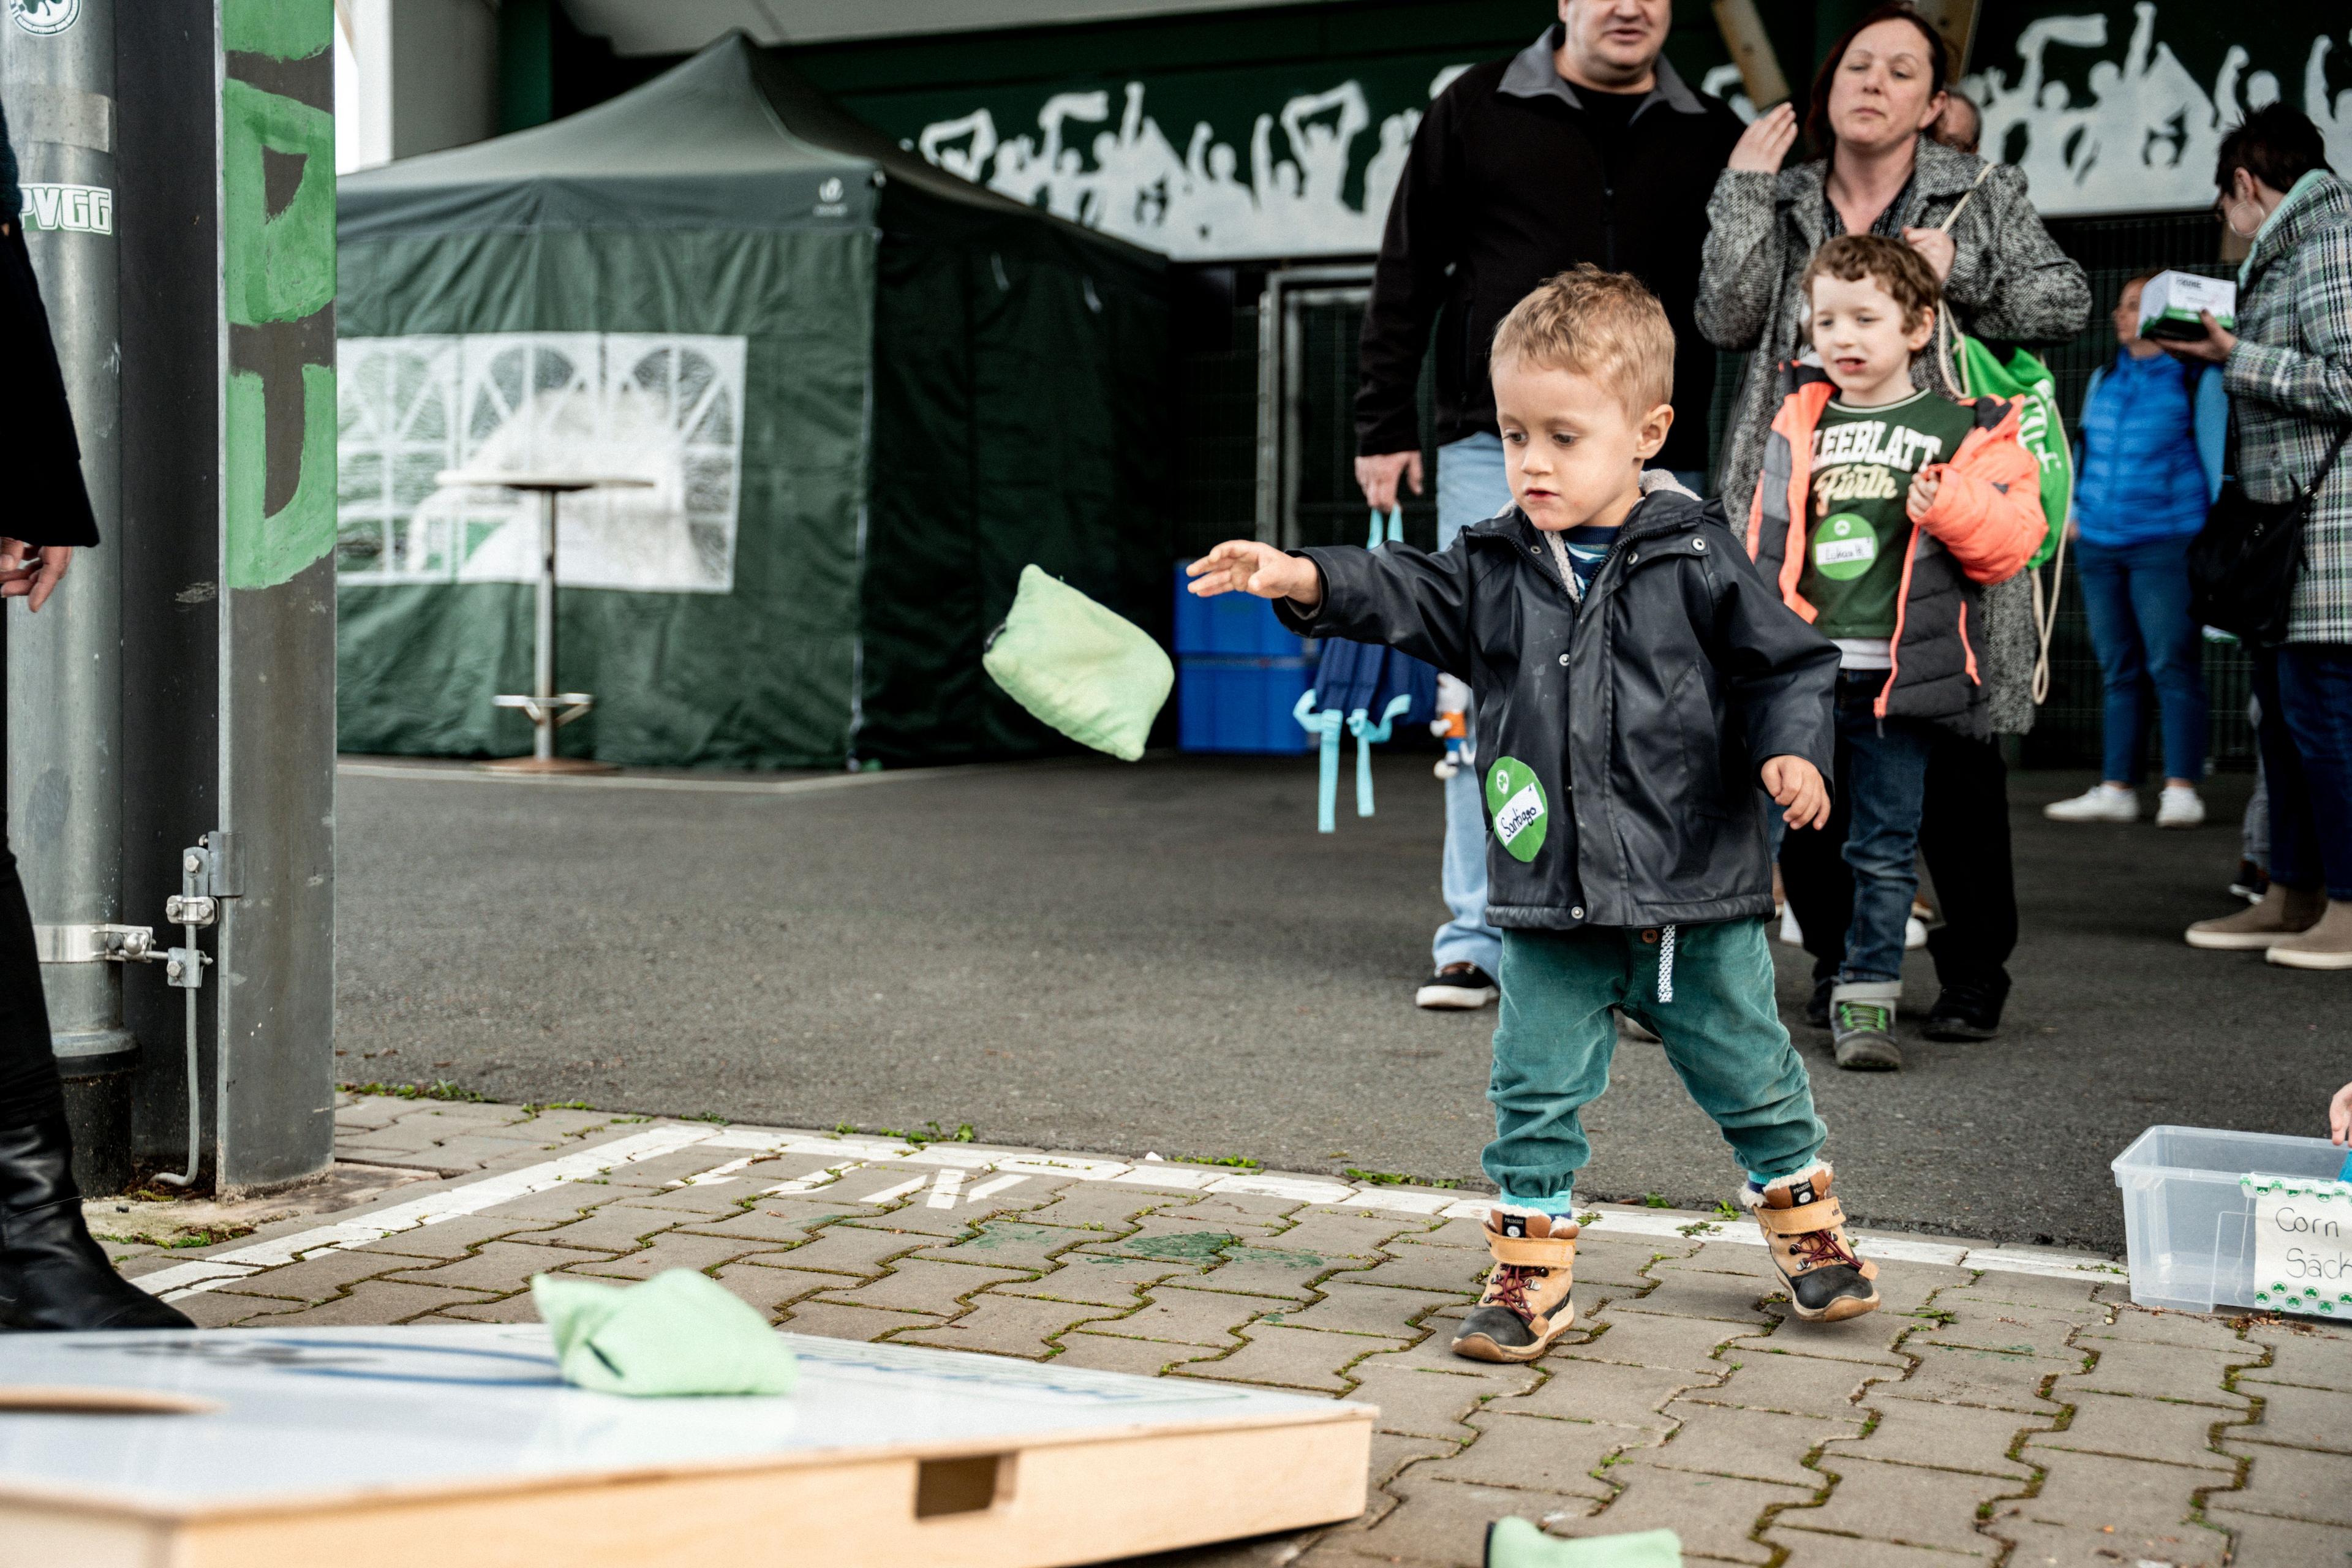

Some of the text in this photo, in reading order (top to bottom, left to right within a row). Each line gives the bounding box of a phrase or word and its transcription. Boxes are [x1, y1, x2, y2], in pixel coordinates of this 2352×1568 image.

[1501, 807, 1537, 837] Santiago
[1793, 1182, 1811, 1194] PRIMIGI
[2275, 1207, 2339, 1237] Corn
